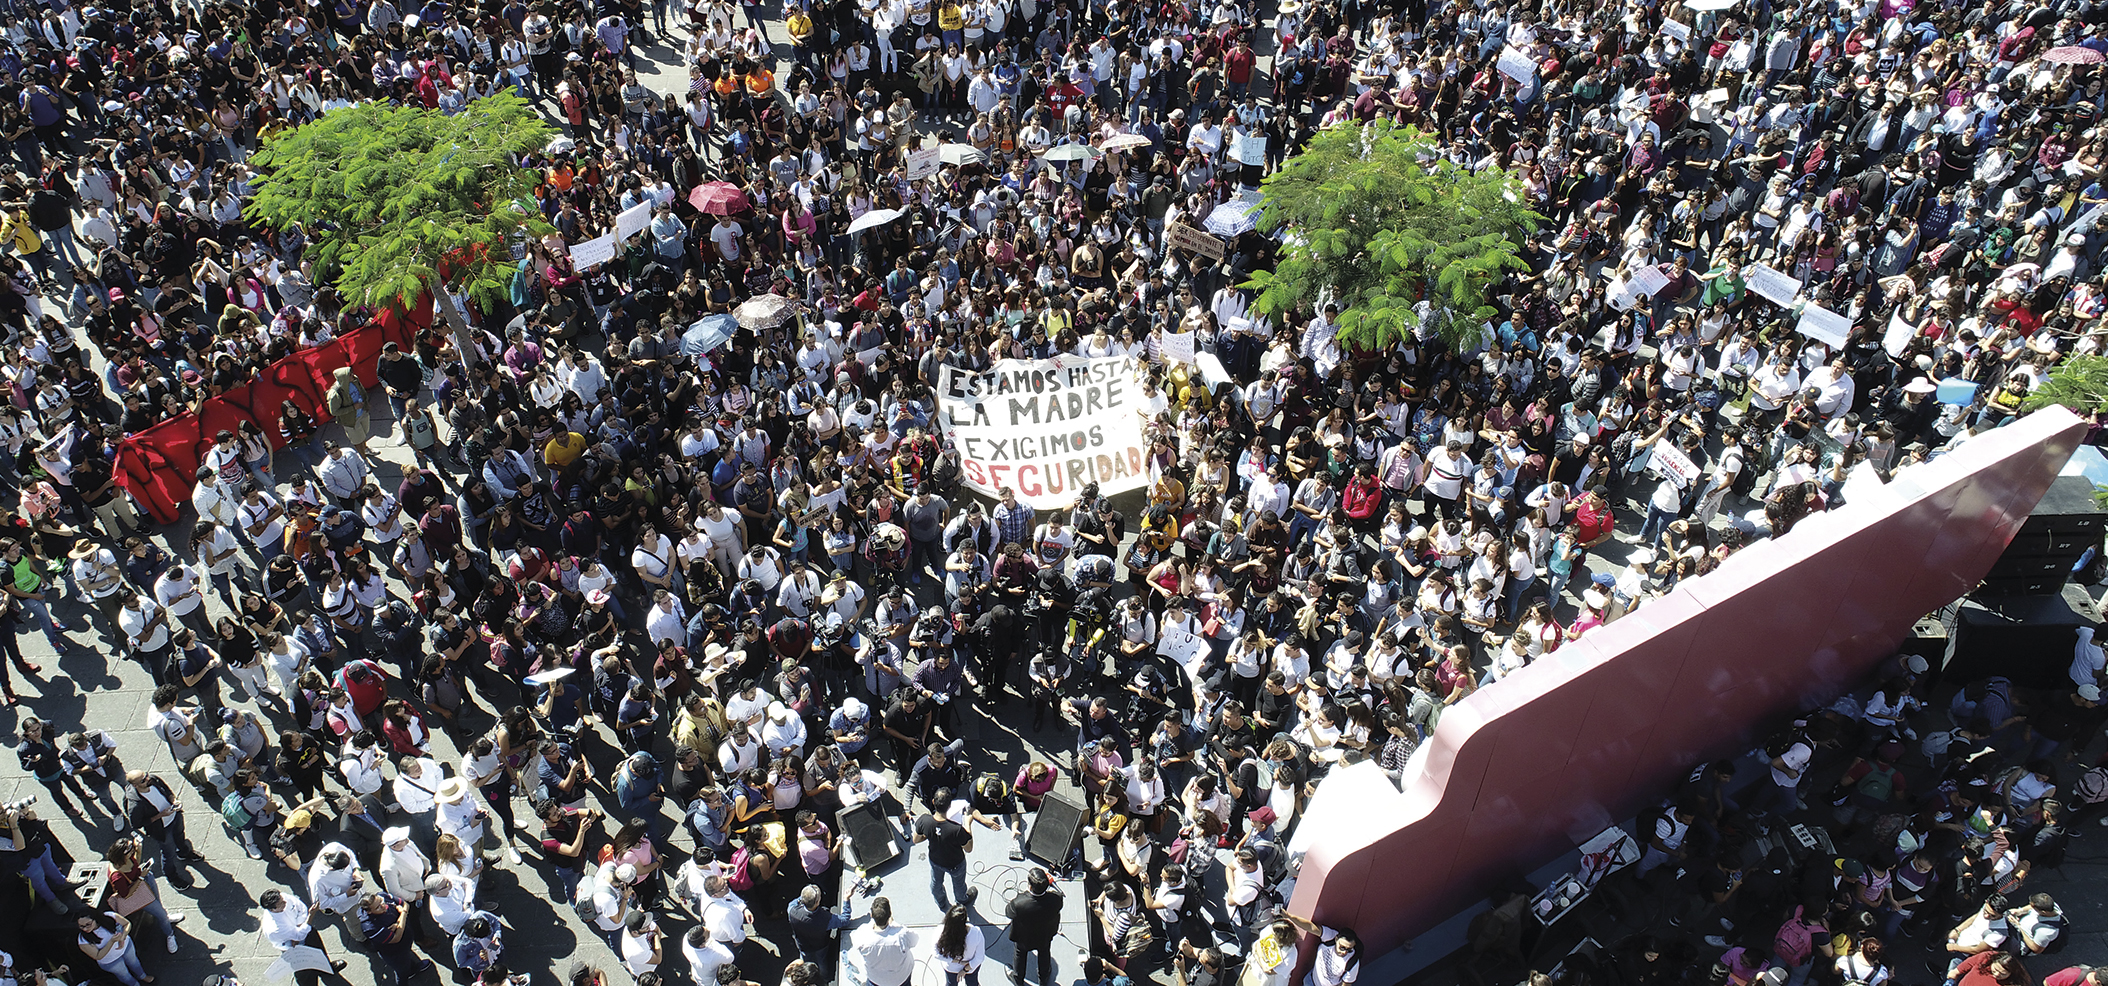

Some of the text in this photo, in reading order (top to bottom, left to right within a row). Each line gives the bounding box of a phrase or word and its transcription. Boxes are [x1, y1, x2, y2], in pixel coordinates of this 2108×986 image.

[1177, 226, 1189, 236] SER
[948, 357, 1134, 398] ESTAMOS HASTA
[948, 378, 1124, 427] LA MADRE
[964, 424, 1105, 462] EXIGIMOS
[963, 446, 1142, 497] SEGURIDAD
